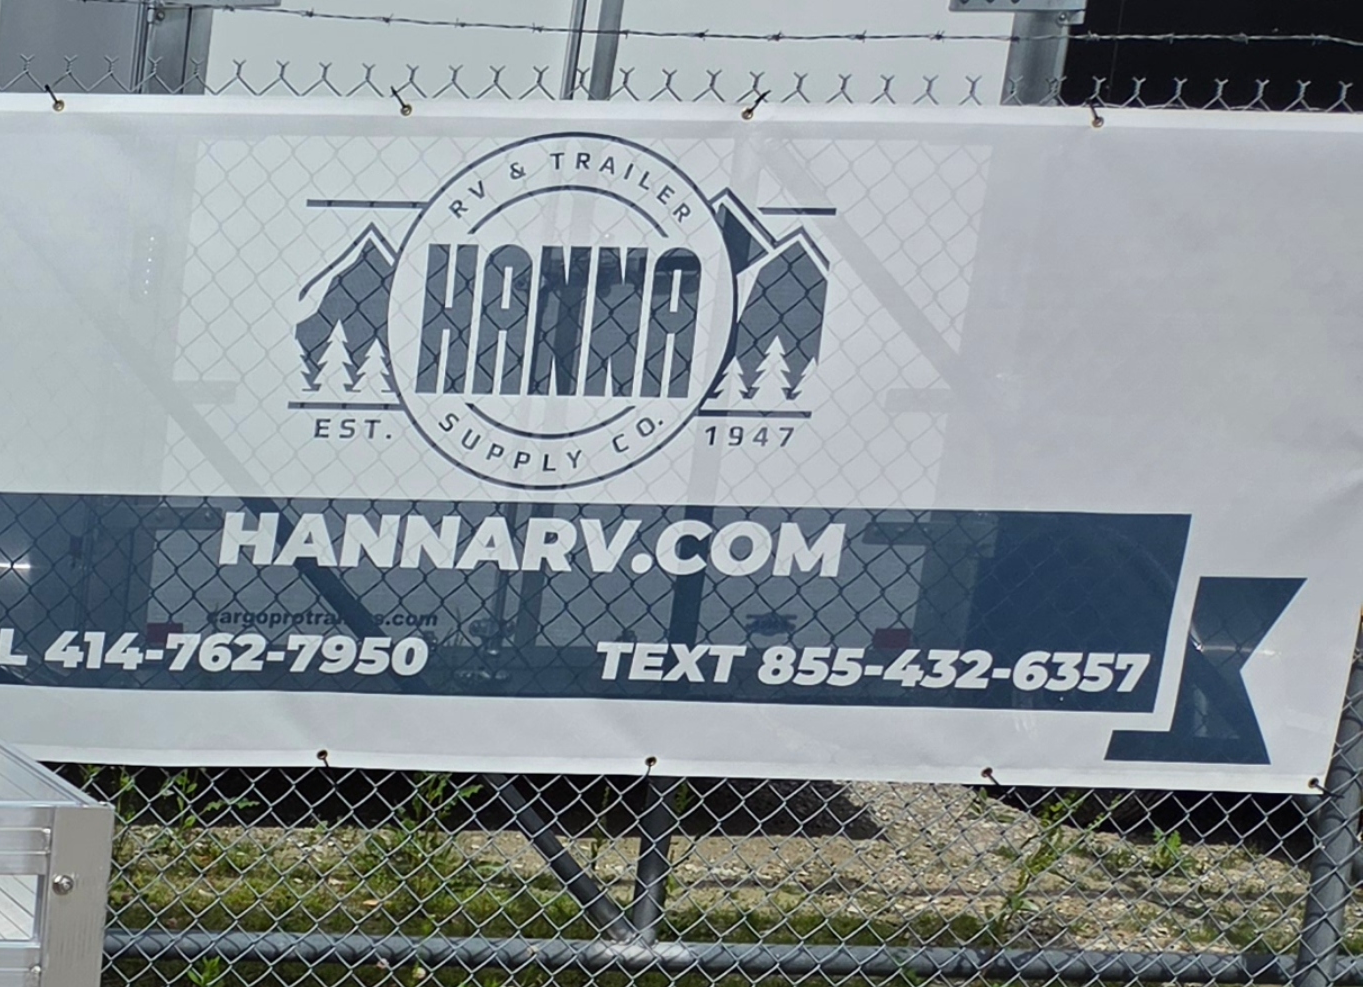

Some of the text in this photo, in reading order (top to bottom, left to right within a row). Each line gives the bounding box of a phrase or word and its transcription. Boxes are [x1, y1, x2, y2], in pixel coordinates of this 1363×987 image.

[448, 151, 692, 223] RV & TRAILER
[415, 243, 702, 399] HANNA
[314, 418, 393, 440] EST.
[438, 412, 665, 472] SUPPLY CO.
[704, 425, 795, 448] 1947
[218, 512, 846, 577] HANNARV.COM
[44, 631, 430, 677] 414-762-7950
[596, 641, 1151, 693] TEXT 855-432-6357
